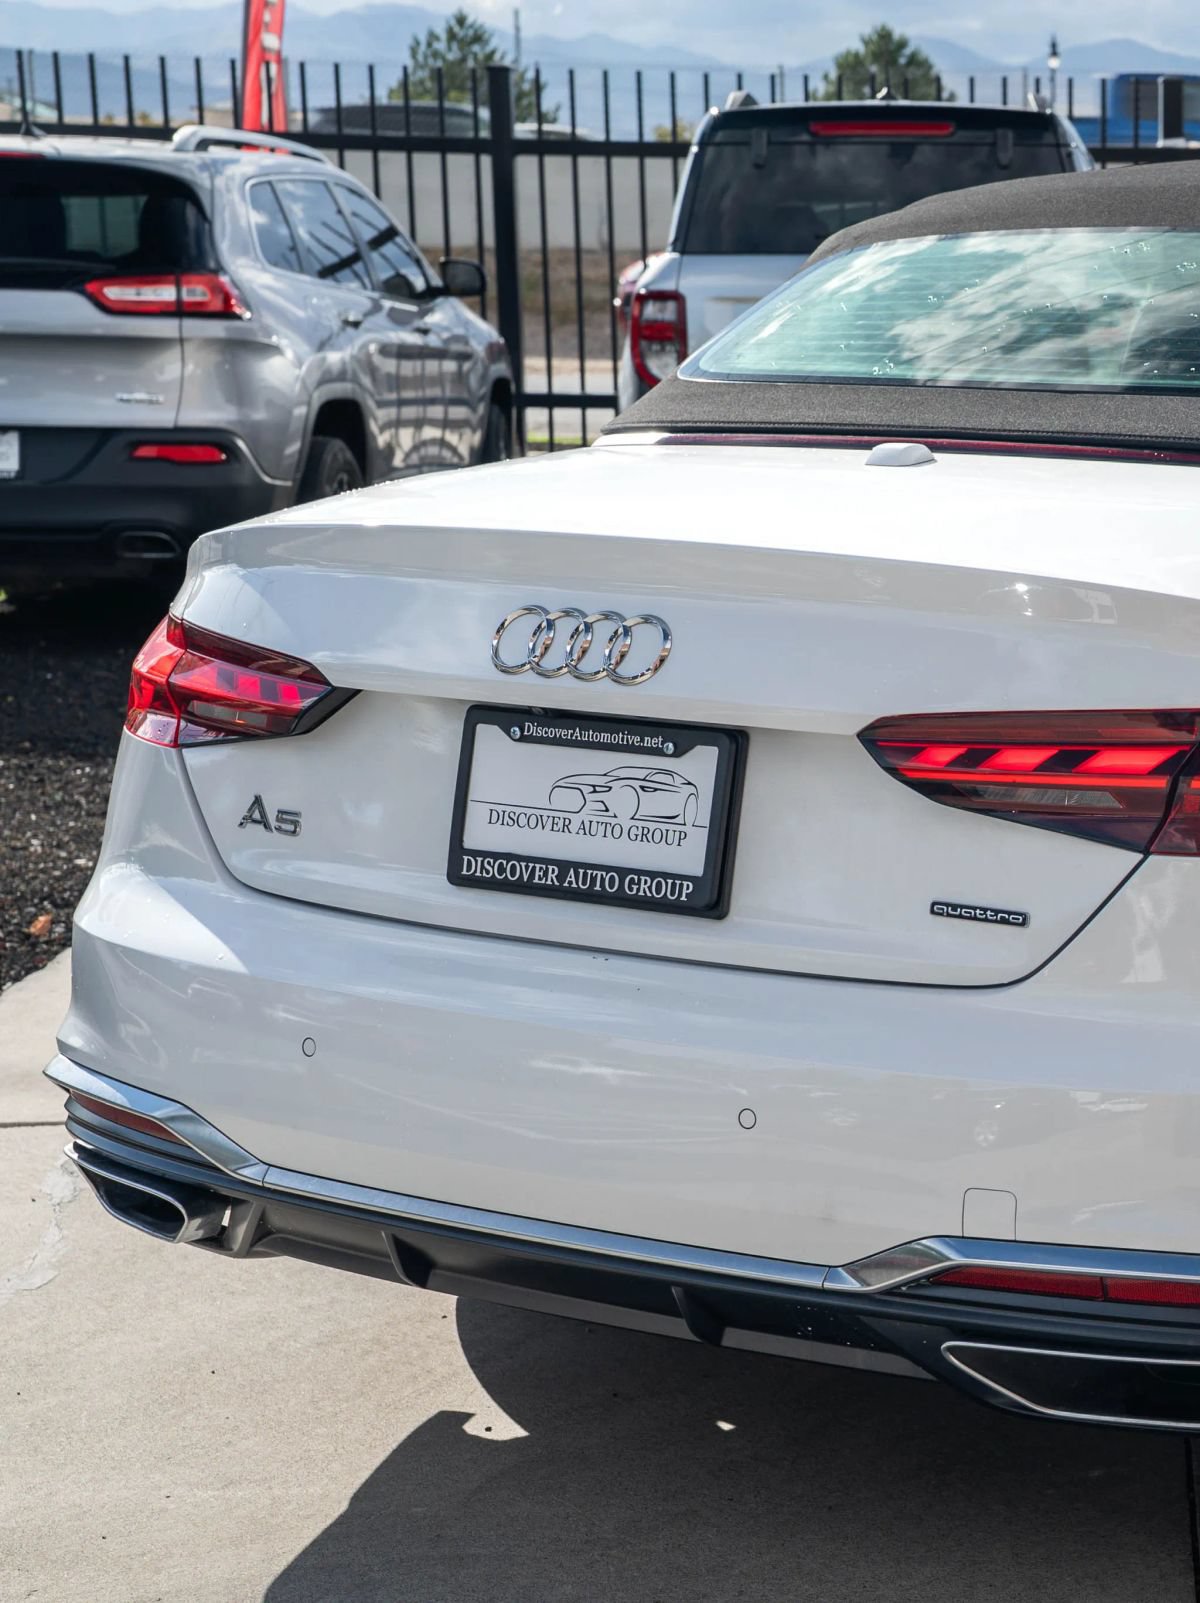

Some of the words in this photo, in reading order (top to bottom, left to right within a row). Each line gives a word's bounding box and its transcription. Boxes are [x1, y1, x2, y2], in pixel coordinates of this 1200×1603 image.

[523, 722, 663, 748] DiscoverAutomotive.net
[238, 794, 302, 837] A5
[488, 808, 572, 834] DISCOVER
[575, 821, 623, 840] AUTO
[627, 825, 688, 847] GROUP
[461, 855, 560, 885] DISCOVER
[563, 870, 619, 892] AUTO
[624, 876, 693, 901] GROUP
[933, 904, 1024, 923] quattro
